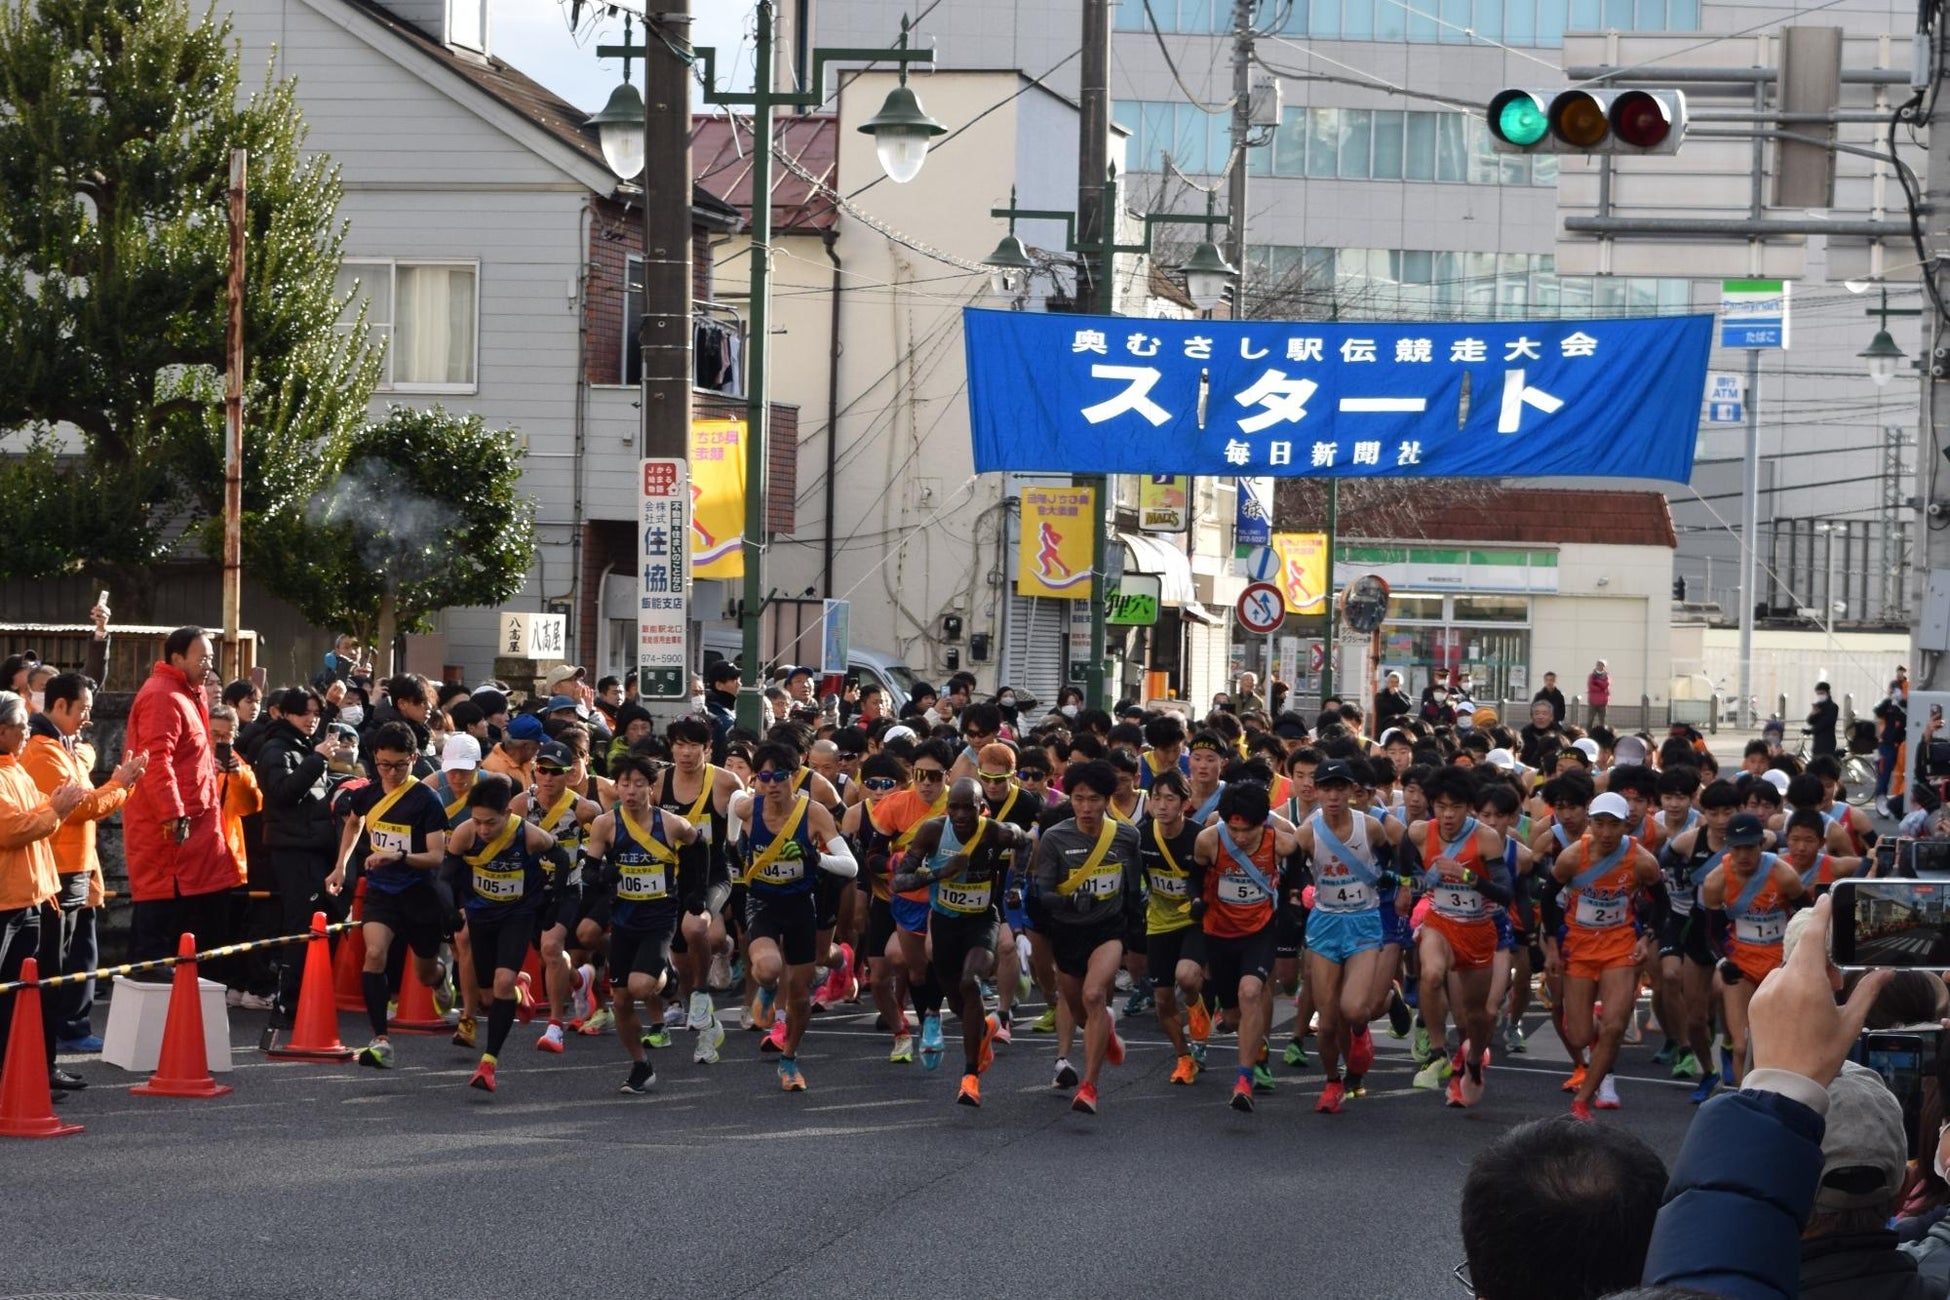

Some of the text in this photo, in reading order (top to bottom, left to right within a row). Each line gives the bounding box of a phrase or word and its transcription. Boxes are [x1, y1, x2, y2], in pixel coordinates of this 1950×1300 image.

[1745, 331, 1775, 343] たばこ
[1072, 329, 1598, 363] 奥むさし駅伝競走大会
[1080, 363, 1564, 434] スタート
[1712, 388, 1738, 399] ATM
[1224, 438, 1422, 467] 毎日新聞社
[644, 527, 667, 592] 住協
[642, 598, 682, 609] 飯能支店
[641, 654, 682, 663] 974-5900
[657, 684, 665, 693] 2
[764, 865, 795, 877] 04-1
[477, 876, 515, 893] 105-1
[1083, 879, 1114, 892] 01-1
[1152, 875, 1186, 892] 114-
[942, 889, 982, 905] 102-1
[1238, 886, 1262, 898] 5-1
[1337, 888, 1362, 901] 4-1
[1451, 893, 1476, 908] 3-1
[1595, 909, 1619, 922] 2-1
[1755, 925, 1779, 938] 1-1
